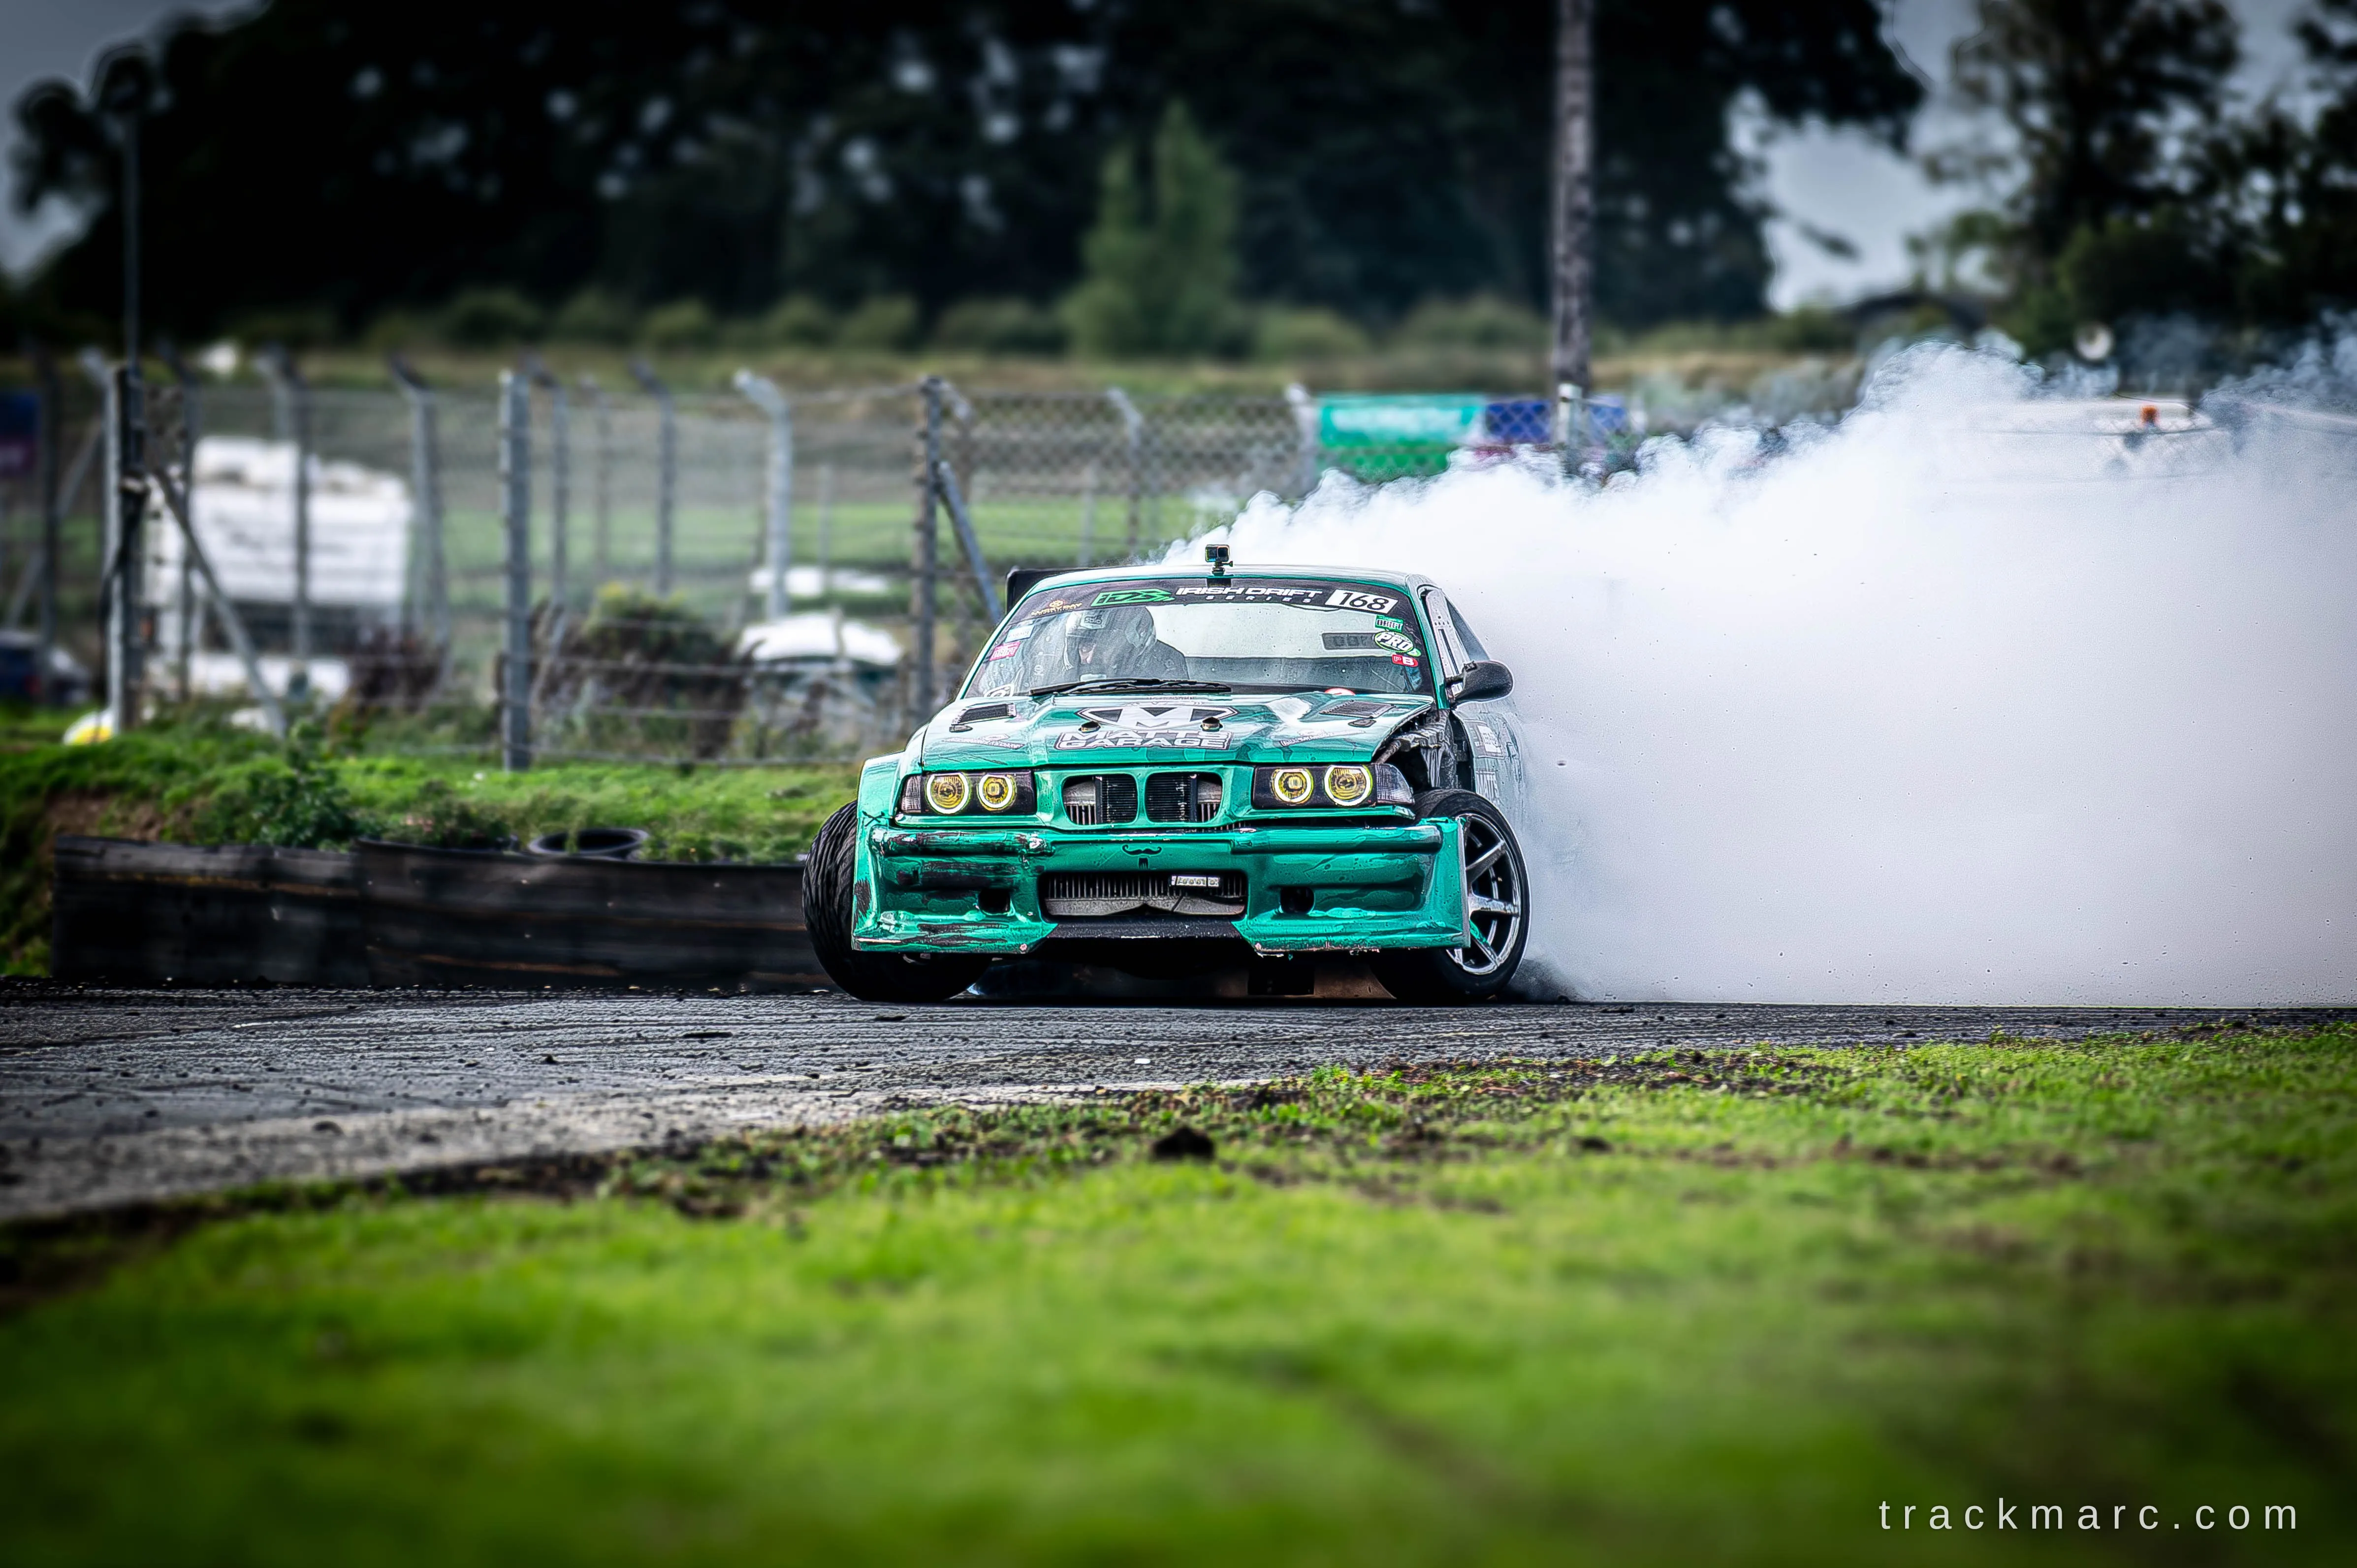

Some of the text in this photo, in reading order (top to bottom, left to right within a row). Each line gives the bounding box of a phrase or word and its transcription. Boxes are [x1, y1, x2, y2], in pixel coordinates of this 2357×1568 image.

[1176, 587, 1323, 597] IRISH DRIFT
[1339, 592, 1389, 611] 168
[1377, 632, 1414, 651] PRO
[1061, 730, 1230, 740] MATTS
[1059, 738, 1228, 748] GARAGE
